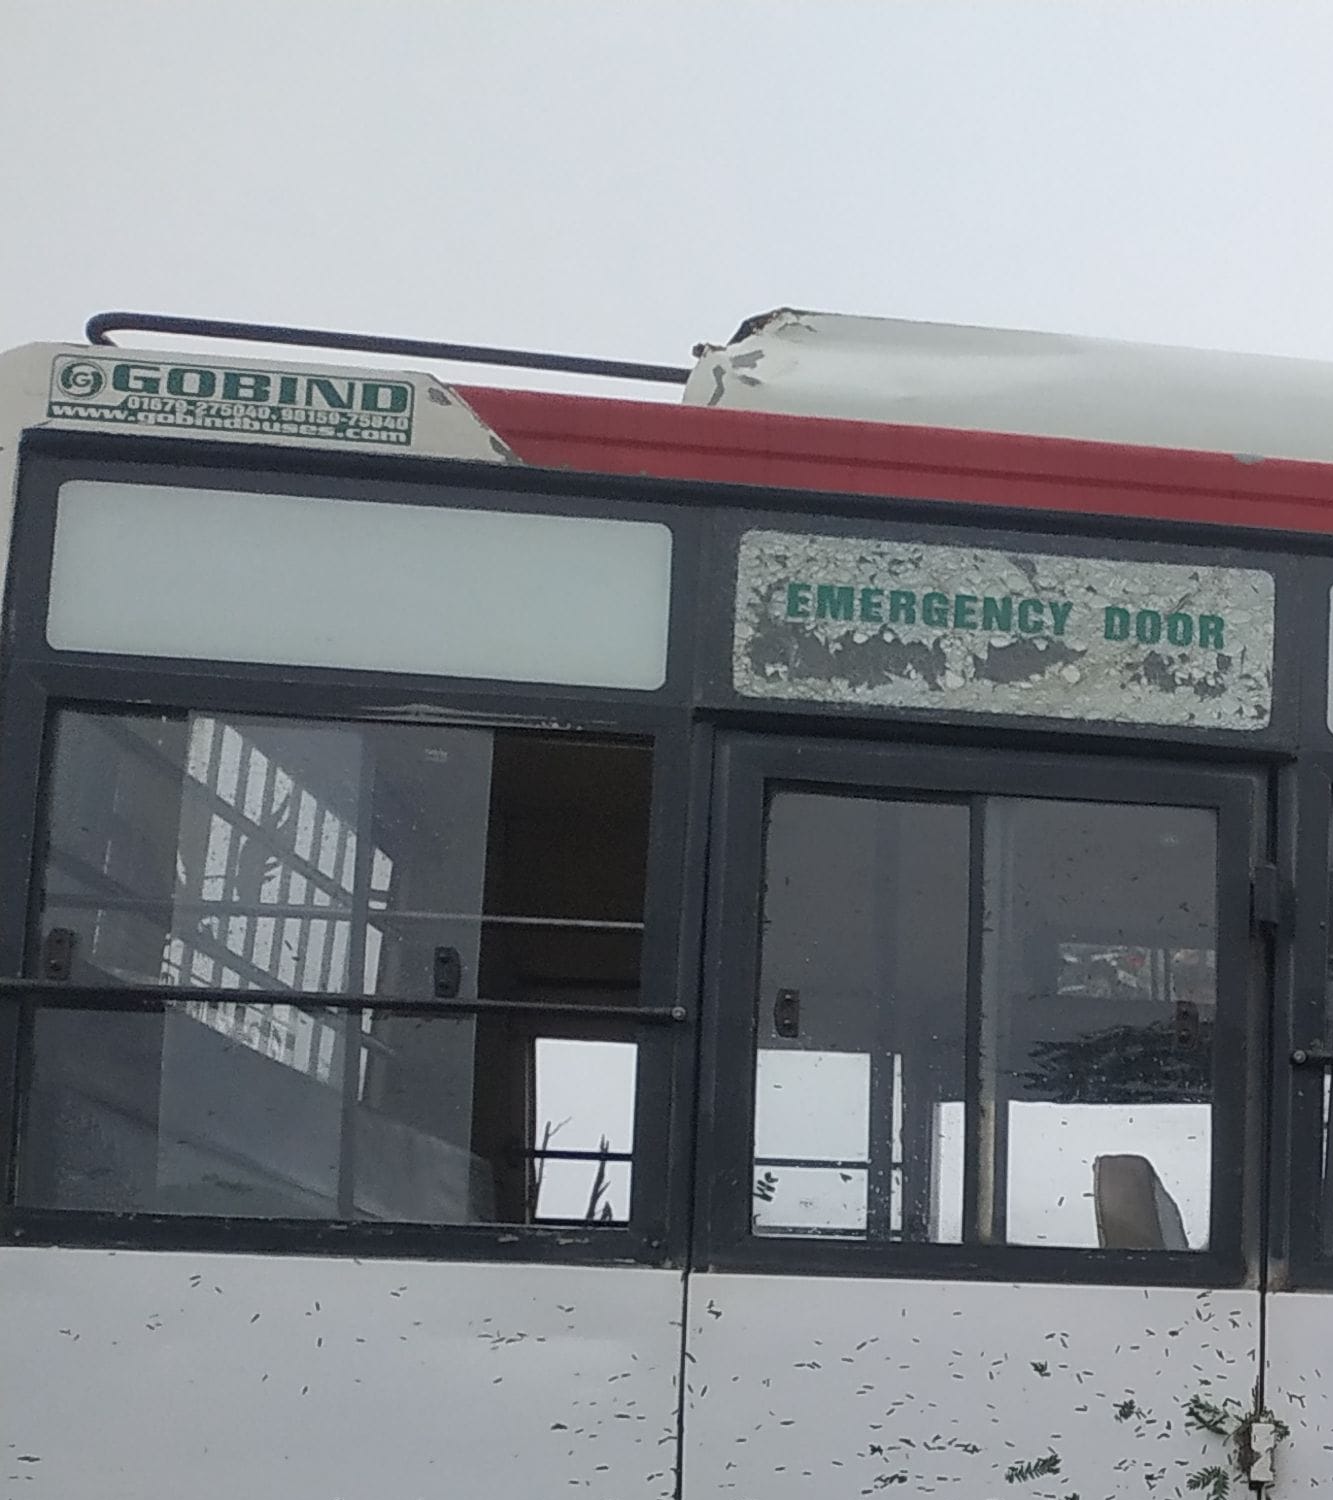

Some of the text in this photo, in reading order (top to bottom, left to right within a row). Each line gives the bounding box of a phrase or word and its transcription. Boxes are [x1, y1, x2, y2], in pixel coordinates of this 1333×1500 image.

[112, 363, 409, 413] GOBIND
[52, 405, 407, 443] www.gobindbuses.com
[787, 583, 1225, 649] EMERGENCY DOOR
